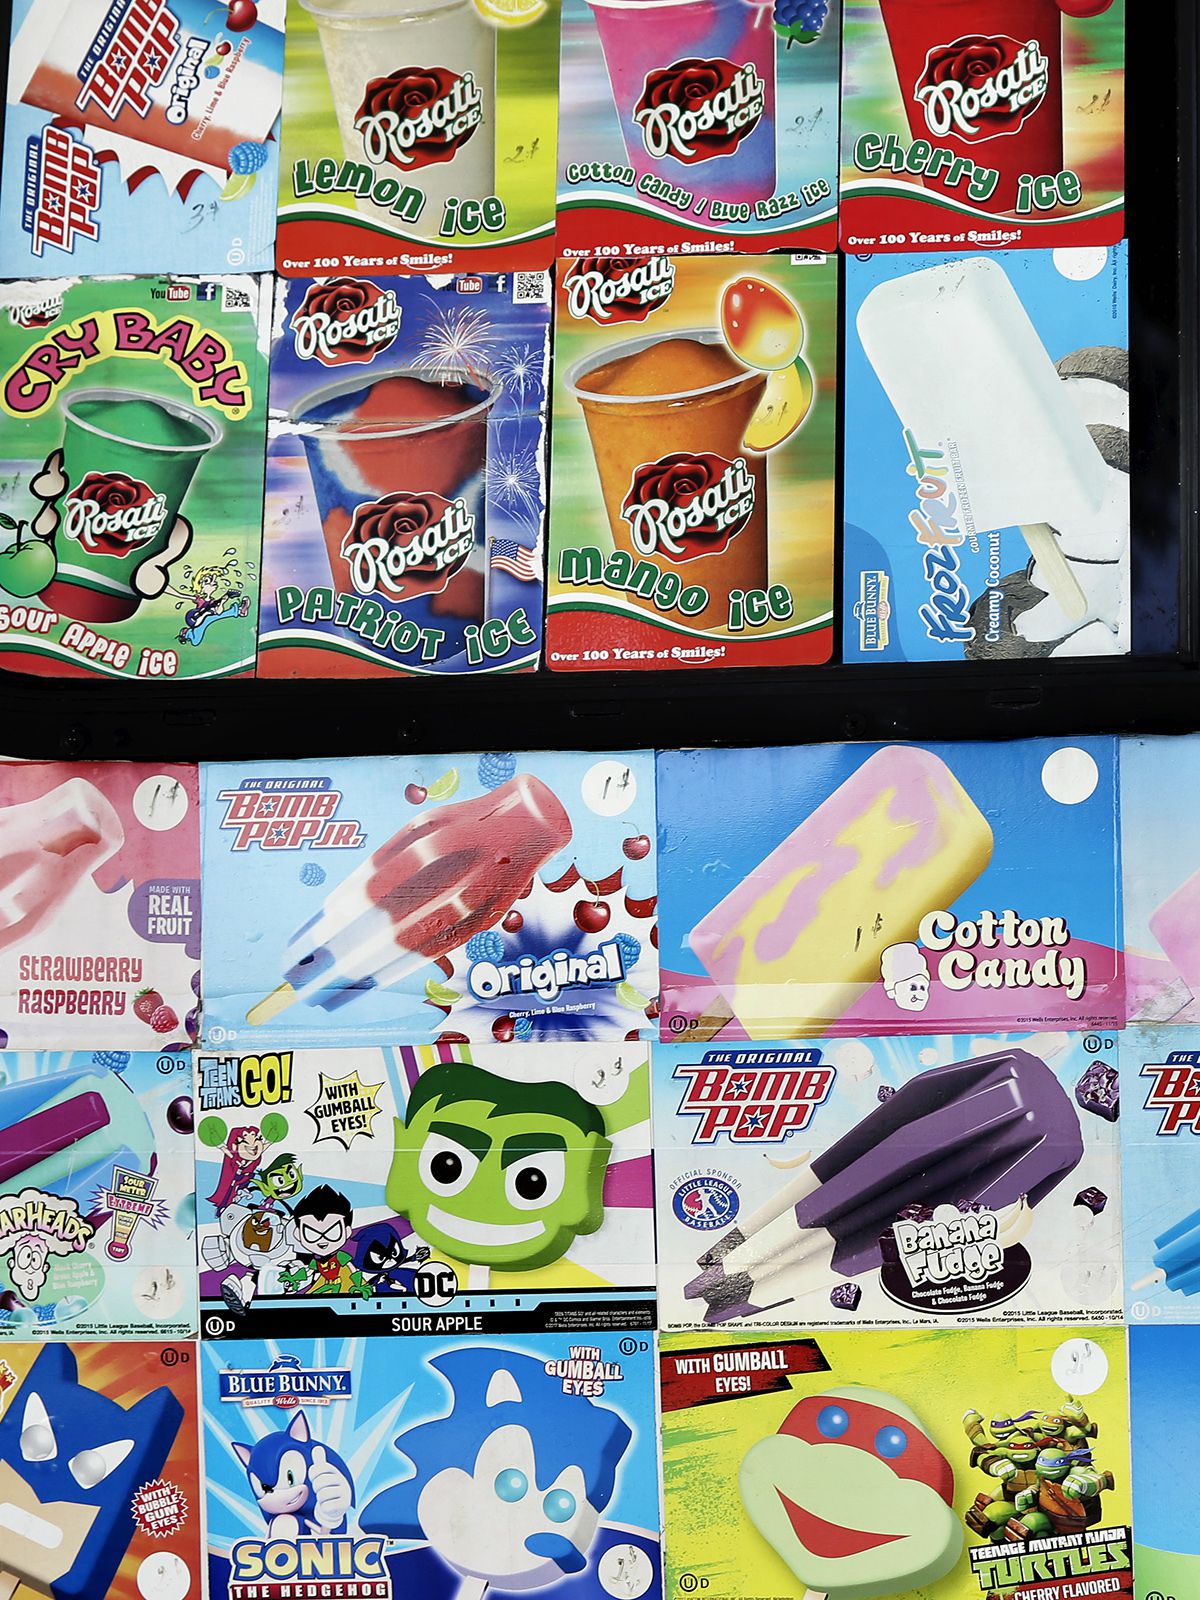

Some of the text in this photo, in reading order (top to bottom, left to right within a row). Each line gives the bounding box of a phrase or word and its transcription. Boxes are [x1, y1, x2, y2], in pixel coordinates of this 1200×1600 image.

[165, 37, 211, 125] Original
[192, 112, 212, 141] Cherry,
[206, 97, 220, 112] Lime
[219, 71, 231, 91] Blue
[227, 36, 251, 73] Raspberry
[916, 41, 1048, 136] Rosati
[1009, 77, 1047, 113] ICE
[354, 72, 484, 165] Rosati
[443, 106, 483, 143] ICE
[634, 64, 765, 157] Rosati
[726, 98, 764, 135] ICE
[567, 161, 636, 185] Cotton
[639, 174, 693, 210] Candy
[854, 133, 999, 202] Cherry
[32, 124, 73, 257] BOMB
[66, 142, 102, 253] POP
[293, 159, 426, 223] Lemon
[283, 253, 453, 269] Over 100 Years of Smiles!
[151, 287, 190, 299] You Tube
[566, 256, 676, 319] Rosati
[640, 280, 673, 304] ICE
[293, 291, 402, 358] Rosati
[366, 319, 399, 347] ICE
[5, 312, 246, 412] CRY BABY
[623, 458, 755, 554] Rosati
[715, 494, 754, 532] ICE
[948, 441, 980, 553] GOURMET FROZEN FRUIT BAR
[65, 495, 168, 546] Rosati
[125, 523, 160, 542] ICE
[343, 498, 475, 593] Rosati
[435, 534, 474, 571] ICE
[985, 532, 1004, 643] Creamy Coconut
[275, 586, 445, 661] PATRIOT
[866, 617, 877, 645] BLUE
[61, 621, 133, 669] Apple
[217, 790, 342, 820] BOMB
[221, 820, 367, 851] POP JR.
[148, 895, 193, 916] REAL
[149, 886, 191, 894] MADE WITH
[148, 917, 192, 936] FRUIT
[919, 910, 1071, 951] Cotton
[469, 942, 626, 1001] Original
[938, 949, 1086, 1001] Candy
[199, 1057, 239, 1088] TEEN
[708, 1052, 813, 1064] THE ORIGINAL
[241, 1051, 293, 1107] GO!
[324, 1082, 359, 1101] WITH
[674, 1065, 835, 1103] BOMB
[200, 1086, 241, 1110] TITANS
[313, 1097, 376, 1119] GUMBALL
[331, 1115, 367, 1133] EYES!
[680, 1103, 813, 1143] POP
[108, 1196, 153, 1215] EXTREME
[0, 1201, 92, 1252] ARHEADS
[896, 1213, 998, 1254] Banana
[905, 1243, 1003, 1288] Fudge
[416, 1272, 456, 1298] DC
[392, 1316, 483, 1331] SOUR APPLE
[545, 1361, 624, 1381] GUMBALL
[569, 1346, 600, 1361] WITH
[675, 1349, 788, 1374] WITH GUMBALL
[228, 1375, 275, 1393] BLUE
[562, 1379, 605, 1397] EYES
[715, 1375, 751, 1393] EYES!
[139, 1494, 179, 1514] BUBBLE
[142, 1487, 171, 1502] WITH
[145, 1505, 179, 1522] GUM
[151, 1517, 179, 1529] EYES
[233, 1538, 386, 1581] SONIC
[970, 1528, 1127, 1561] TEENAGE MUTANT NINJA
[973, 1541, 1131, 1589] TURTLES
[233, 1583, 387, 1599] THE HEDGEHOG
[1014, 1577, 1121, 1600] CHERRY FLAVORED
